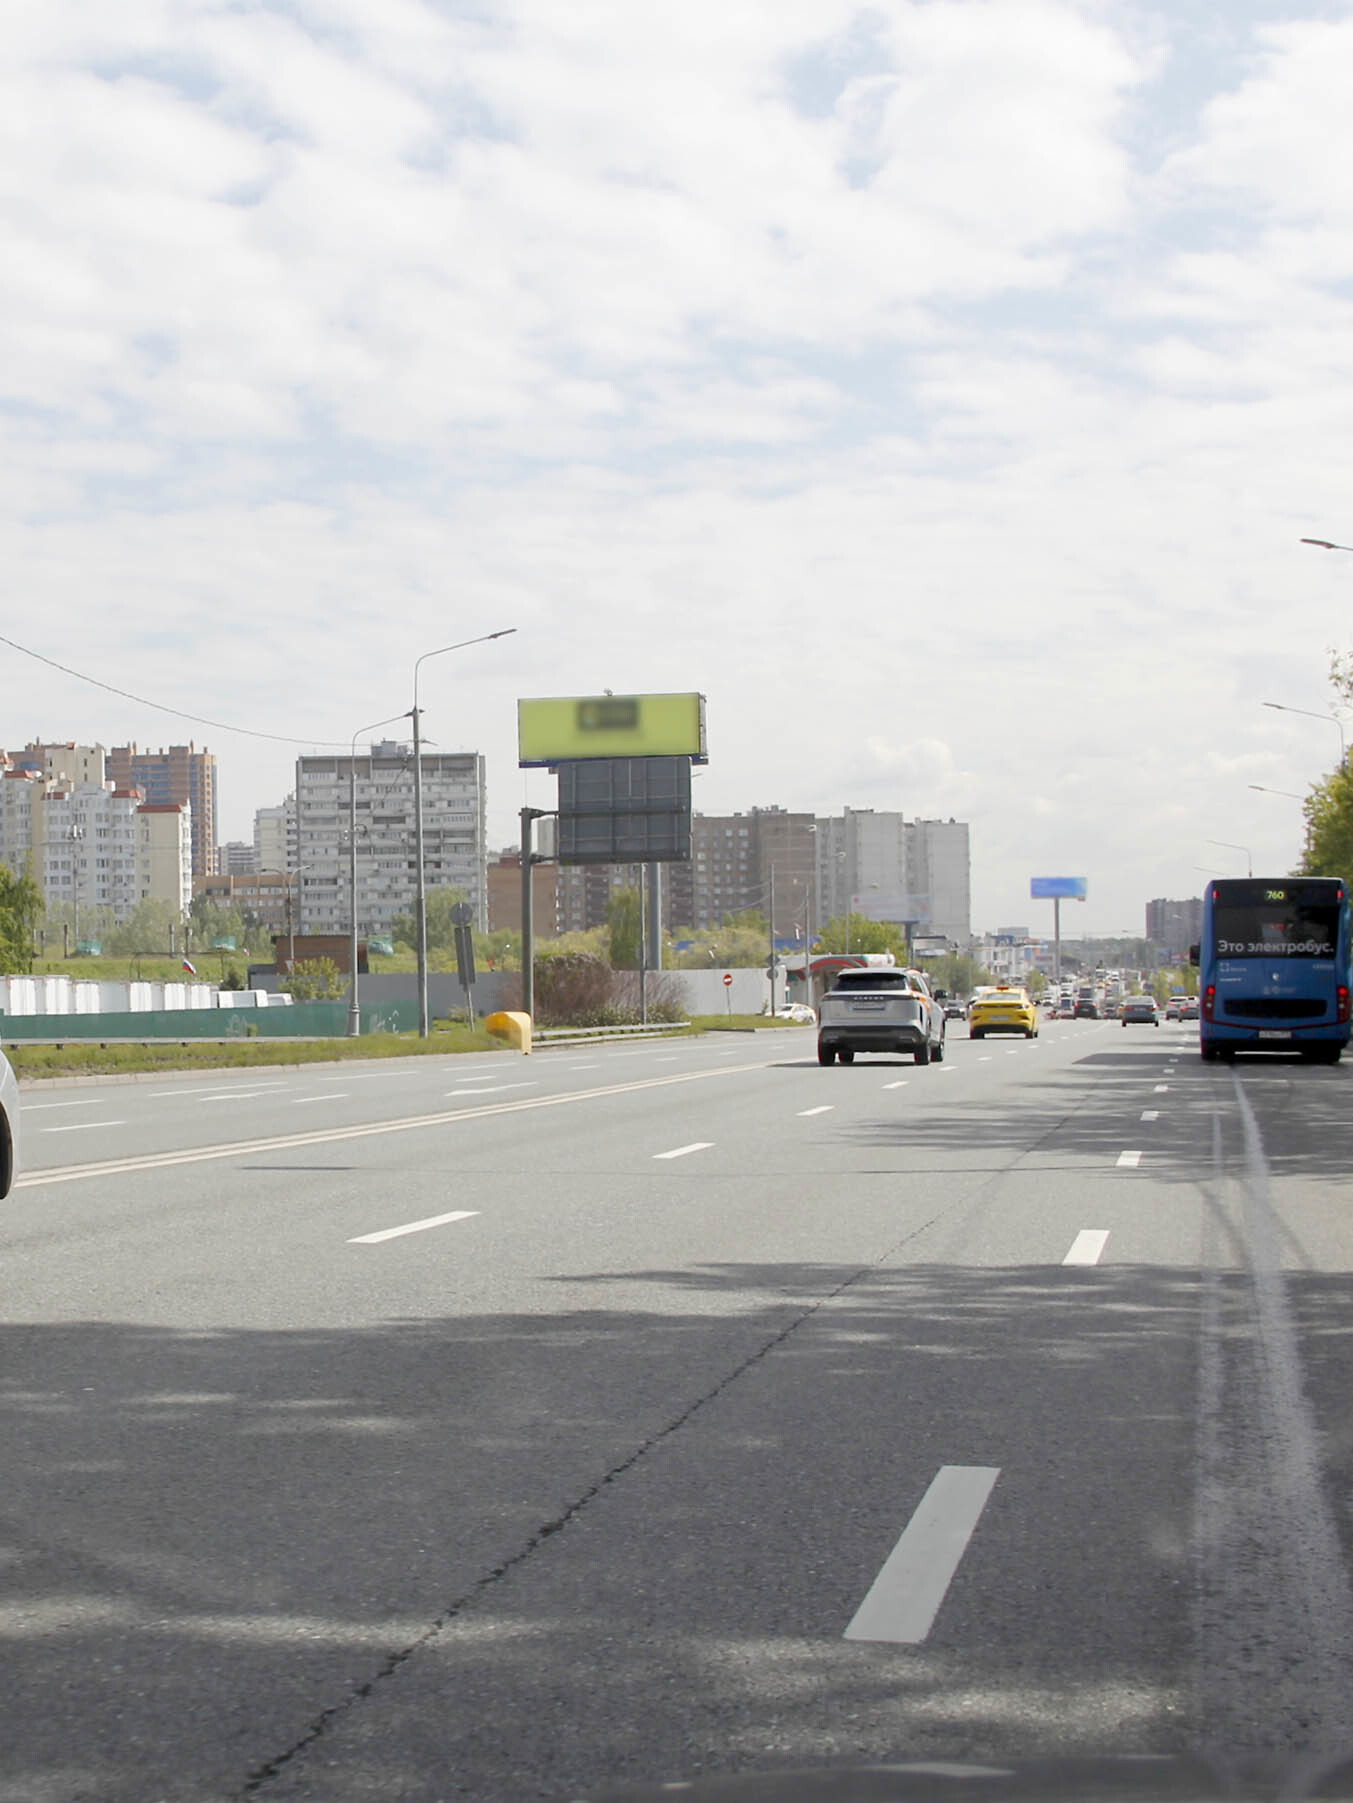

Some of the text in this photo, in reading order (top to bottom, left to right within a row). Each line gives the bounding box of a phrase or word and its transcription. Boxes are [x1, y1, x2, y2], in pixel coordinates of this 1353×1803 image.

[1266, 890, 1285, 900] 760
[1218, 939, 1335, 955] Это электробус.
